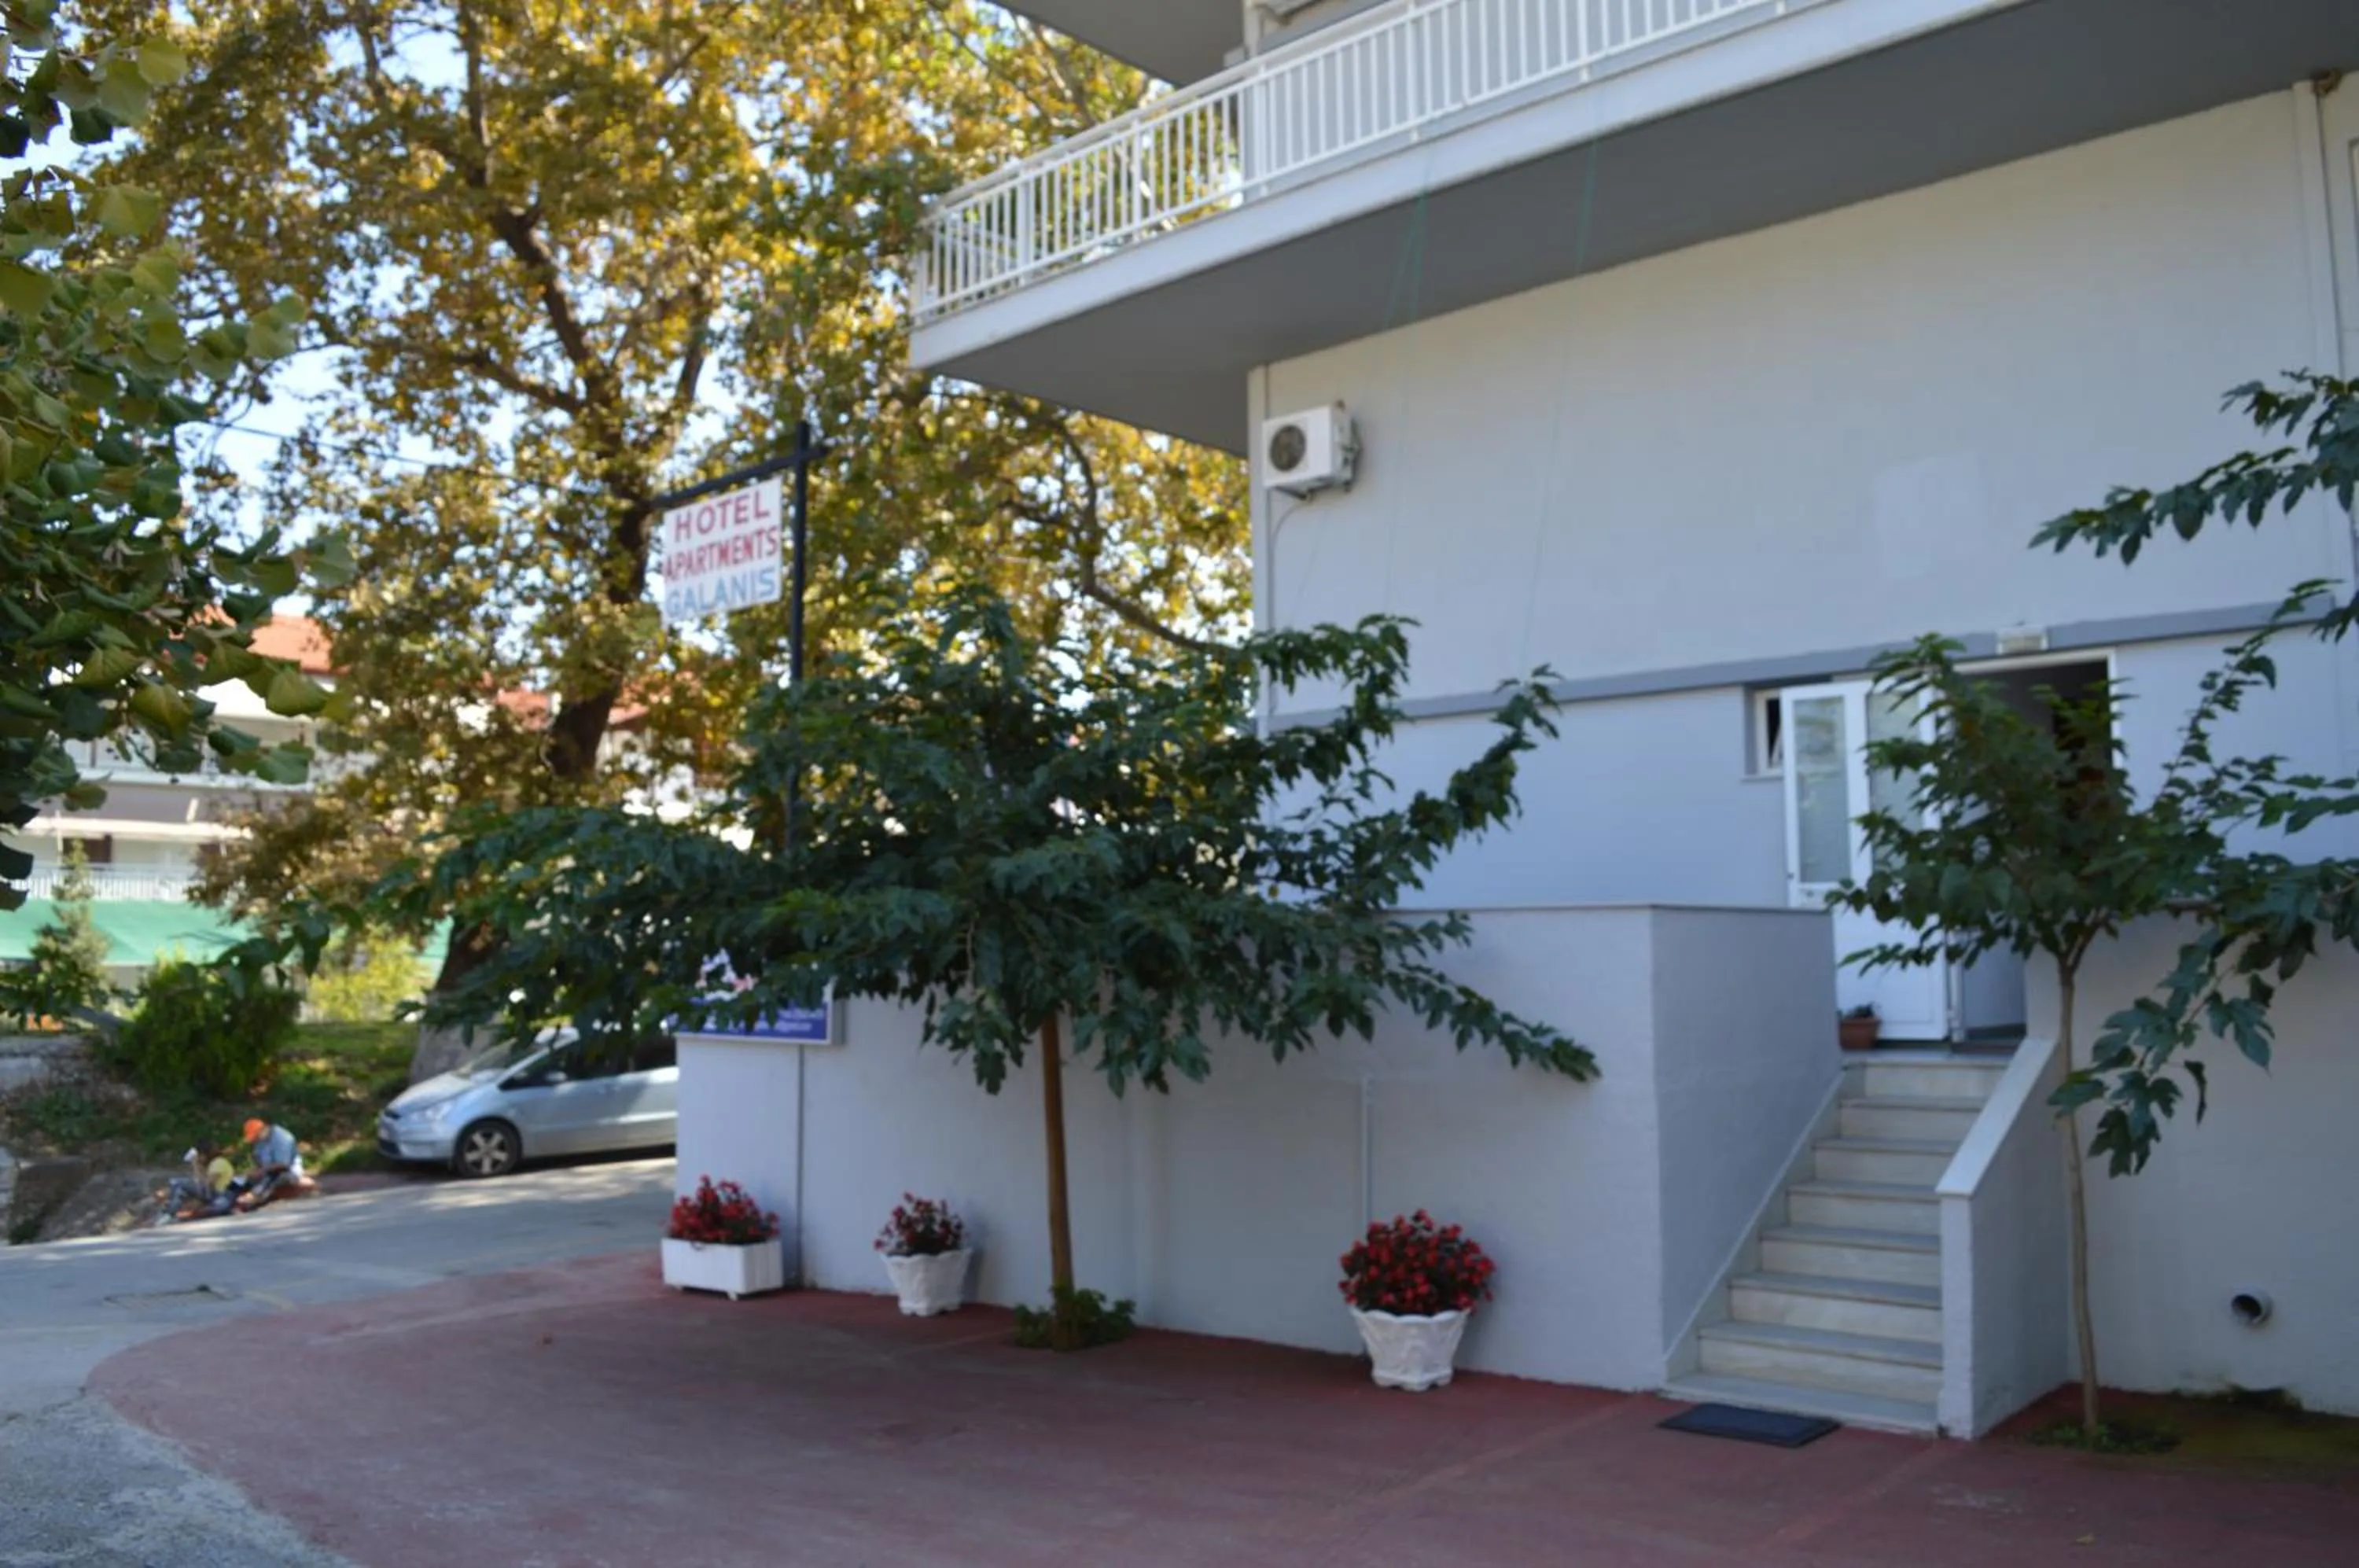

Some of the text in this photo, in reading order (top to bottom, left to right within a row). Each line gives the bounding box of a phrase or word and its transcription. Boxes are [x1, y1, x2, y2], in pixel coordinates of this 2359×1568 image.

[675, 491, 770, 543] HOTEL
[664, 526, 778, 583] APARTMENTS
[667, 567, 775, 618] GALANIS
